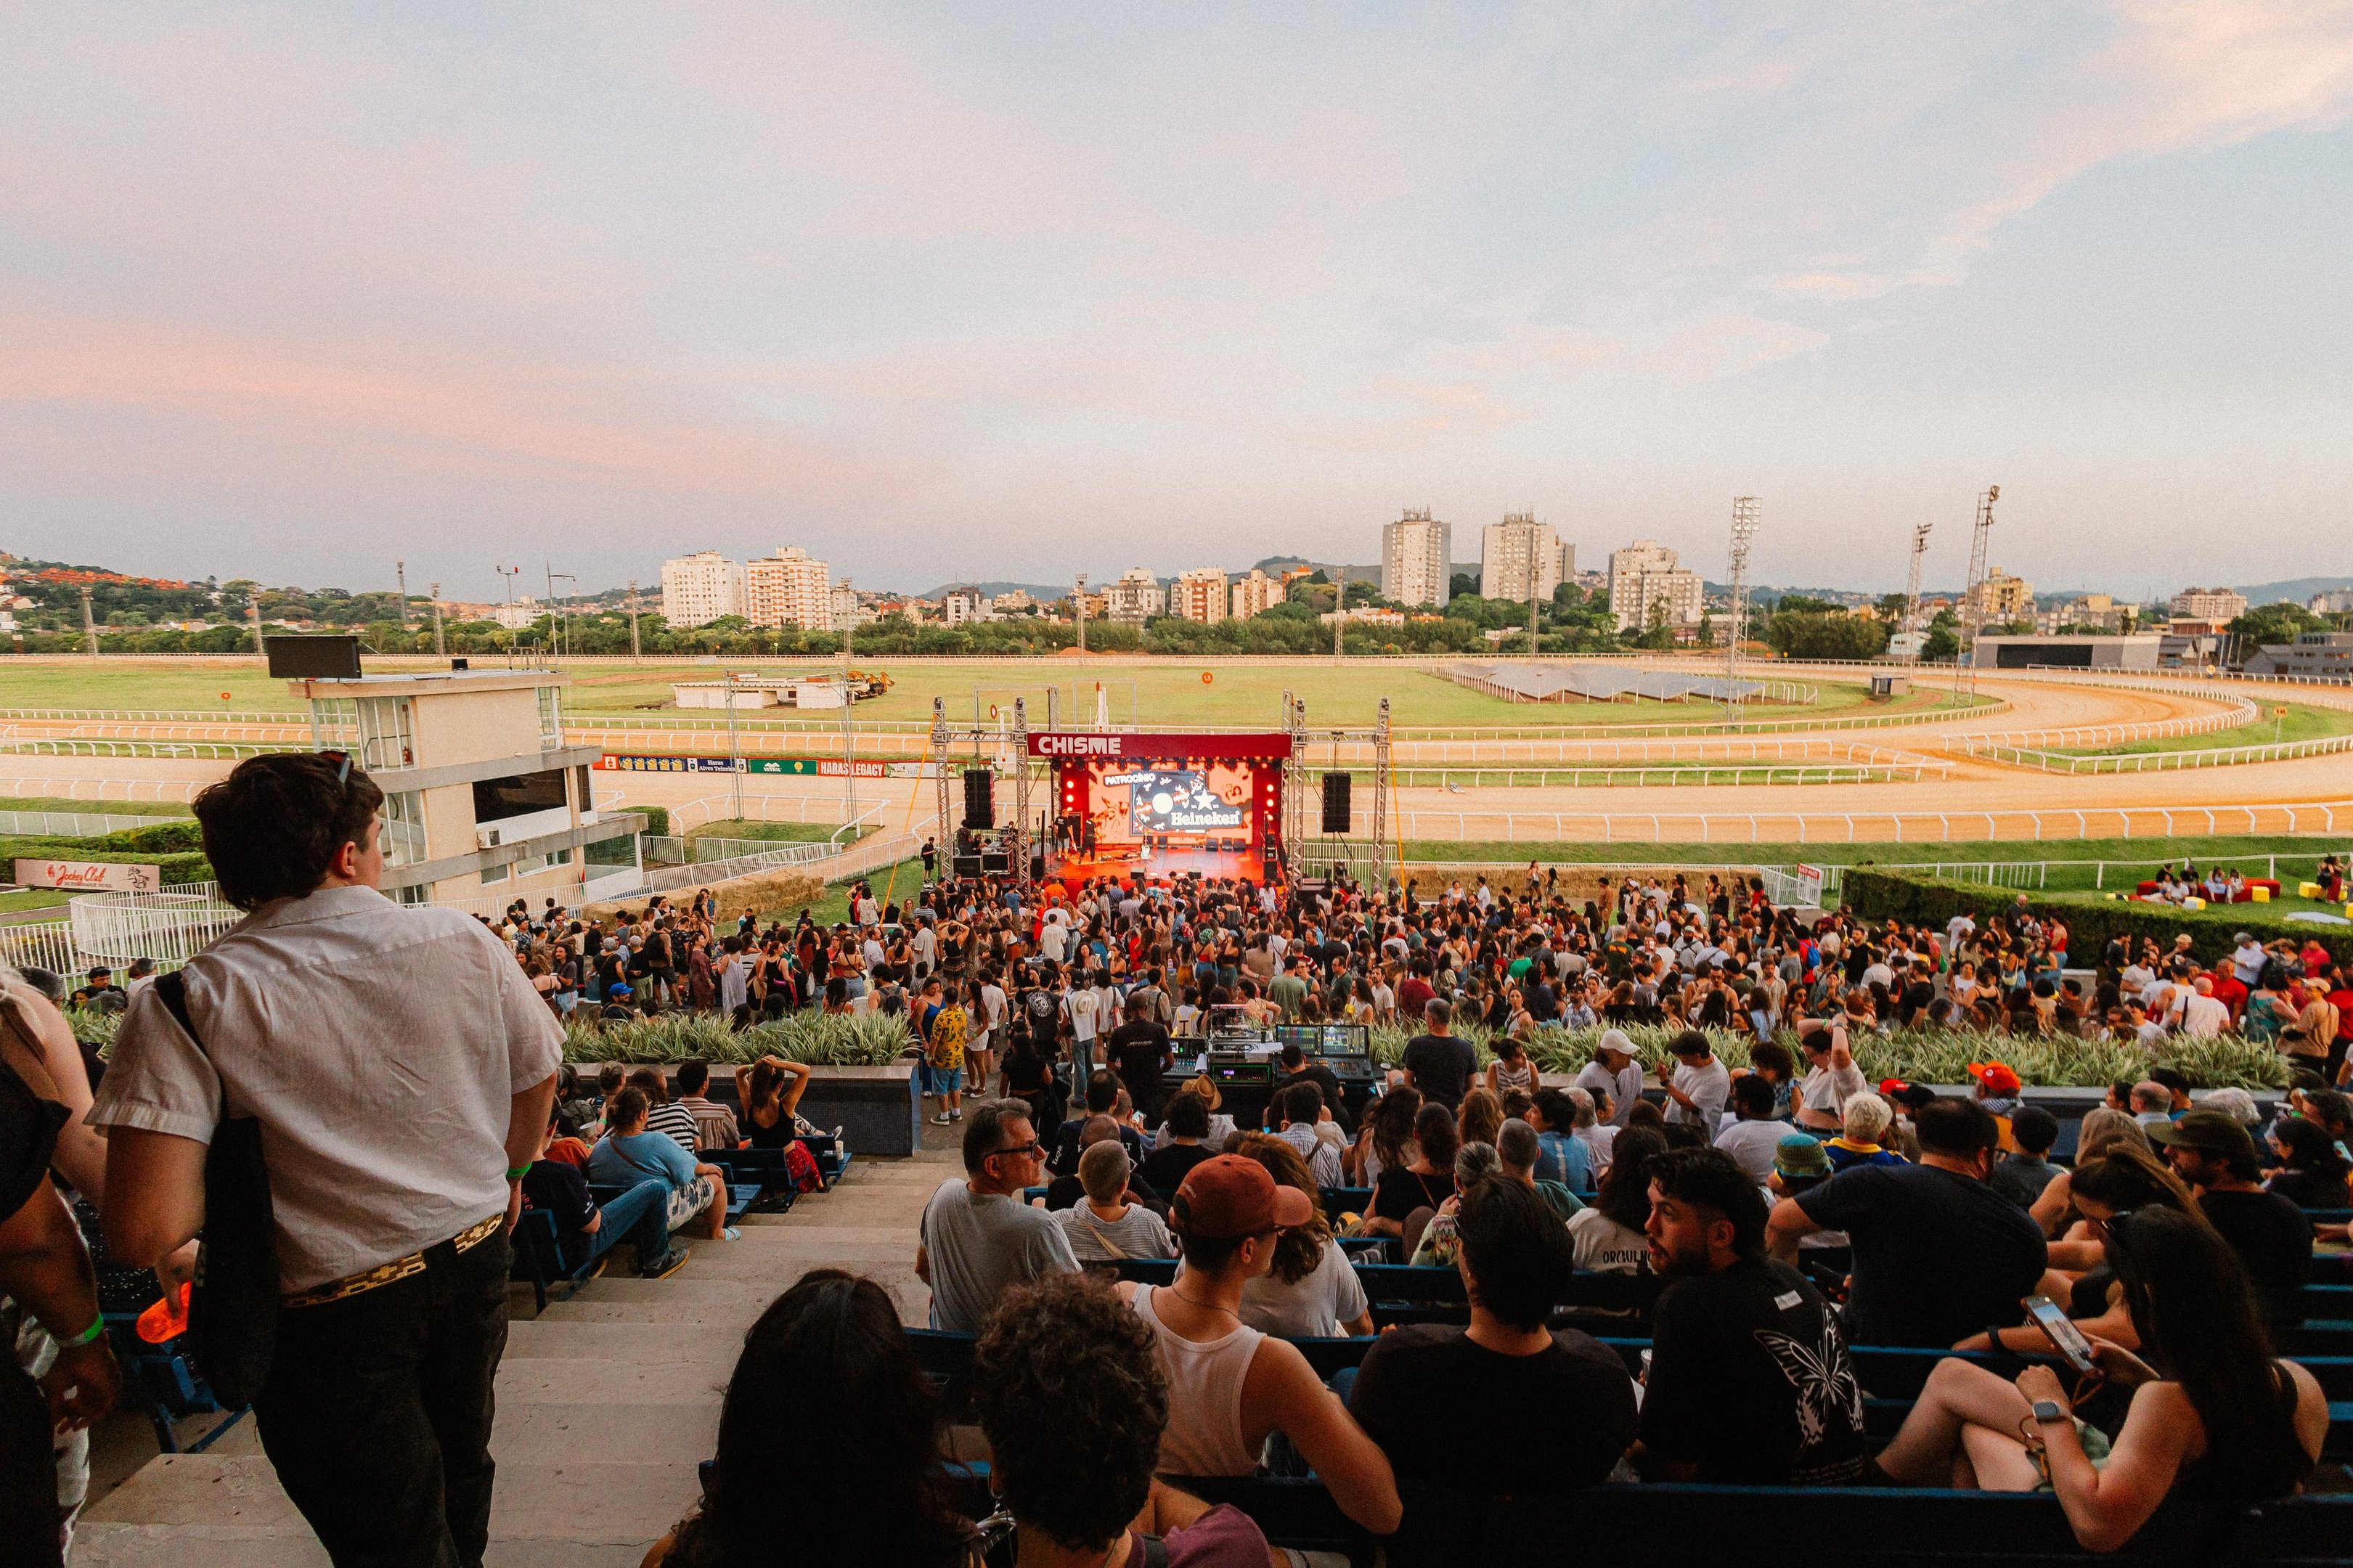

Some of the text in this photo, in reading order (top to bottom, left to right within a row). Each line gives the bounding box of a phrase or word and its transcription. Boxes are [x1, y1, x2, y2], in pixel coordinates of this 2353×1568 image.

[1038, 736, 1121, 754] CHISME
[820, 761, 883, 777] HARAS LEGACY
[1170, 812, 1241, 826] Heineken
[56, 865, 107, 886] Jockey Club
